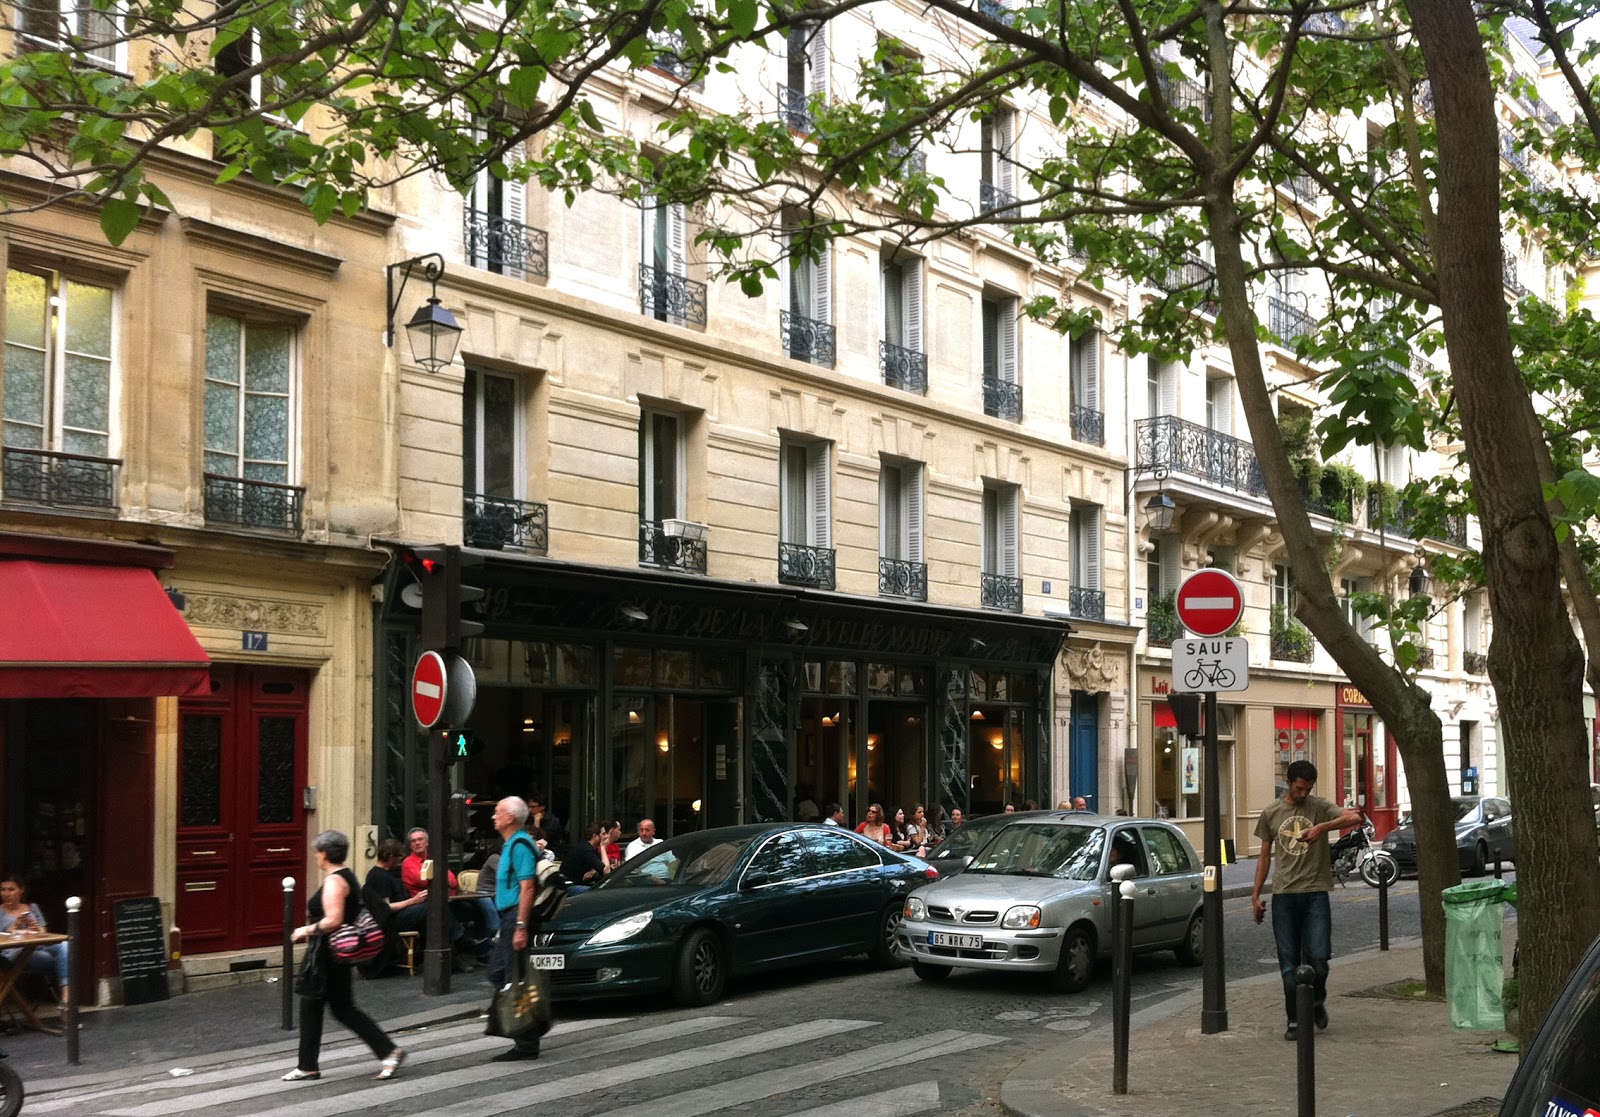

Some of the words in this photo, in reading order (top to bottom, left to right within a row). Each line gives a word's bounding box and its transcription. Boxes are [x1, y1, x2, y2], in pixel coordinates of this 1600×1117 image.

[247, 633, 263, 649] 17
[1186, 641, 1233, 655] SAUF
[969, 936, 980, 947] 75
